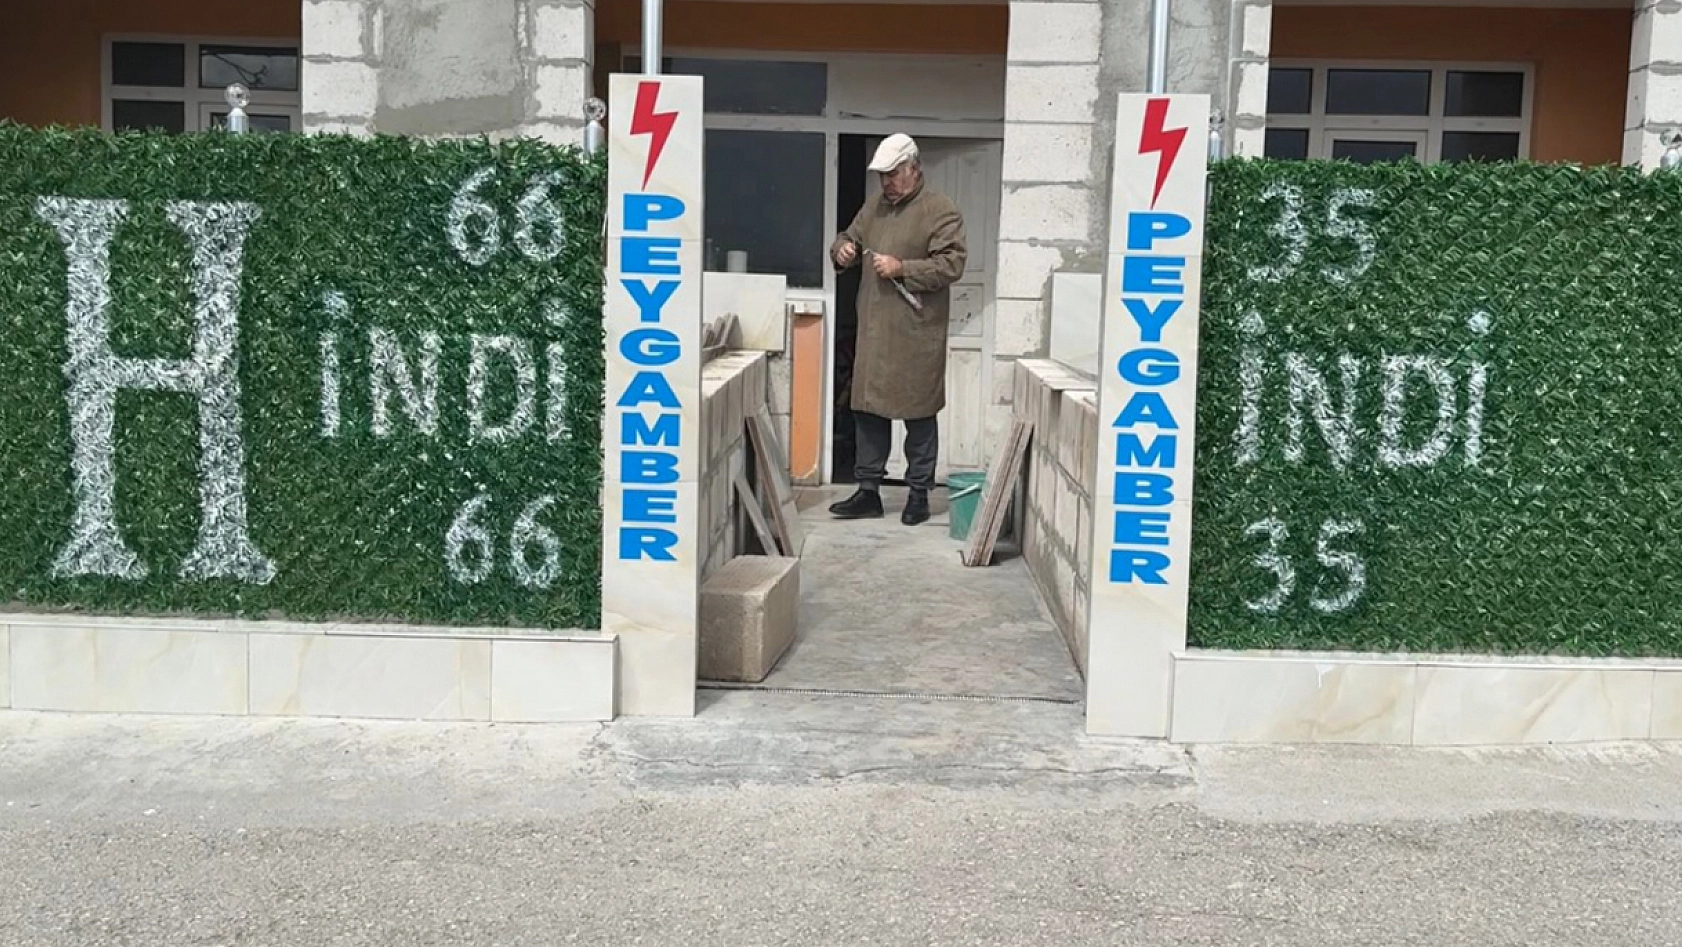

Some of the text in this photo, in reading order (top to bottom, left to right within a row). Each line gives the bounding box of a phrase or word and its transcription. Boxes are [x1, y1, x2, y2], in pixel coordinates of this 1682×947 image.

[445, 166, 566, 265] 66
[1247, 183, 1377, 284] 35
[36, 195, 277, 585] H
[618, 193, 686, 562] PEYGAMBER
[1108, 211, 1192, 585] PEYGAMBER
[444, 496, 563, 589] 66
[1244, 516, 1367, 613] 35
